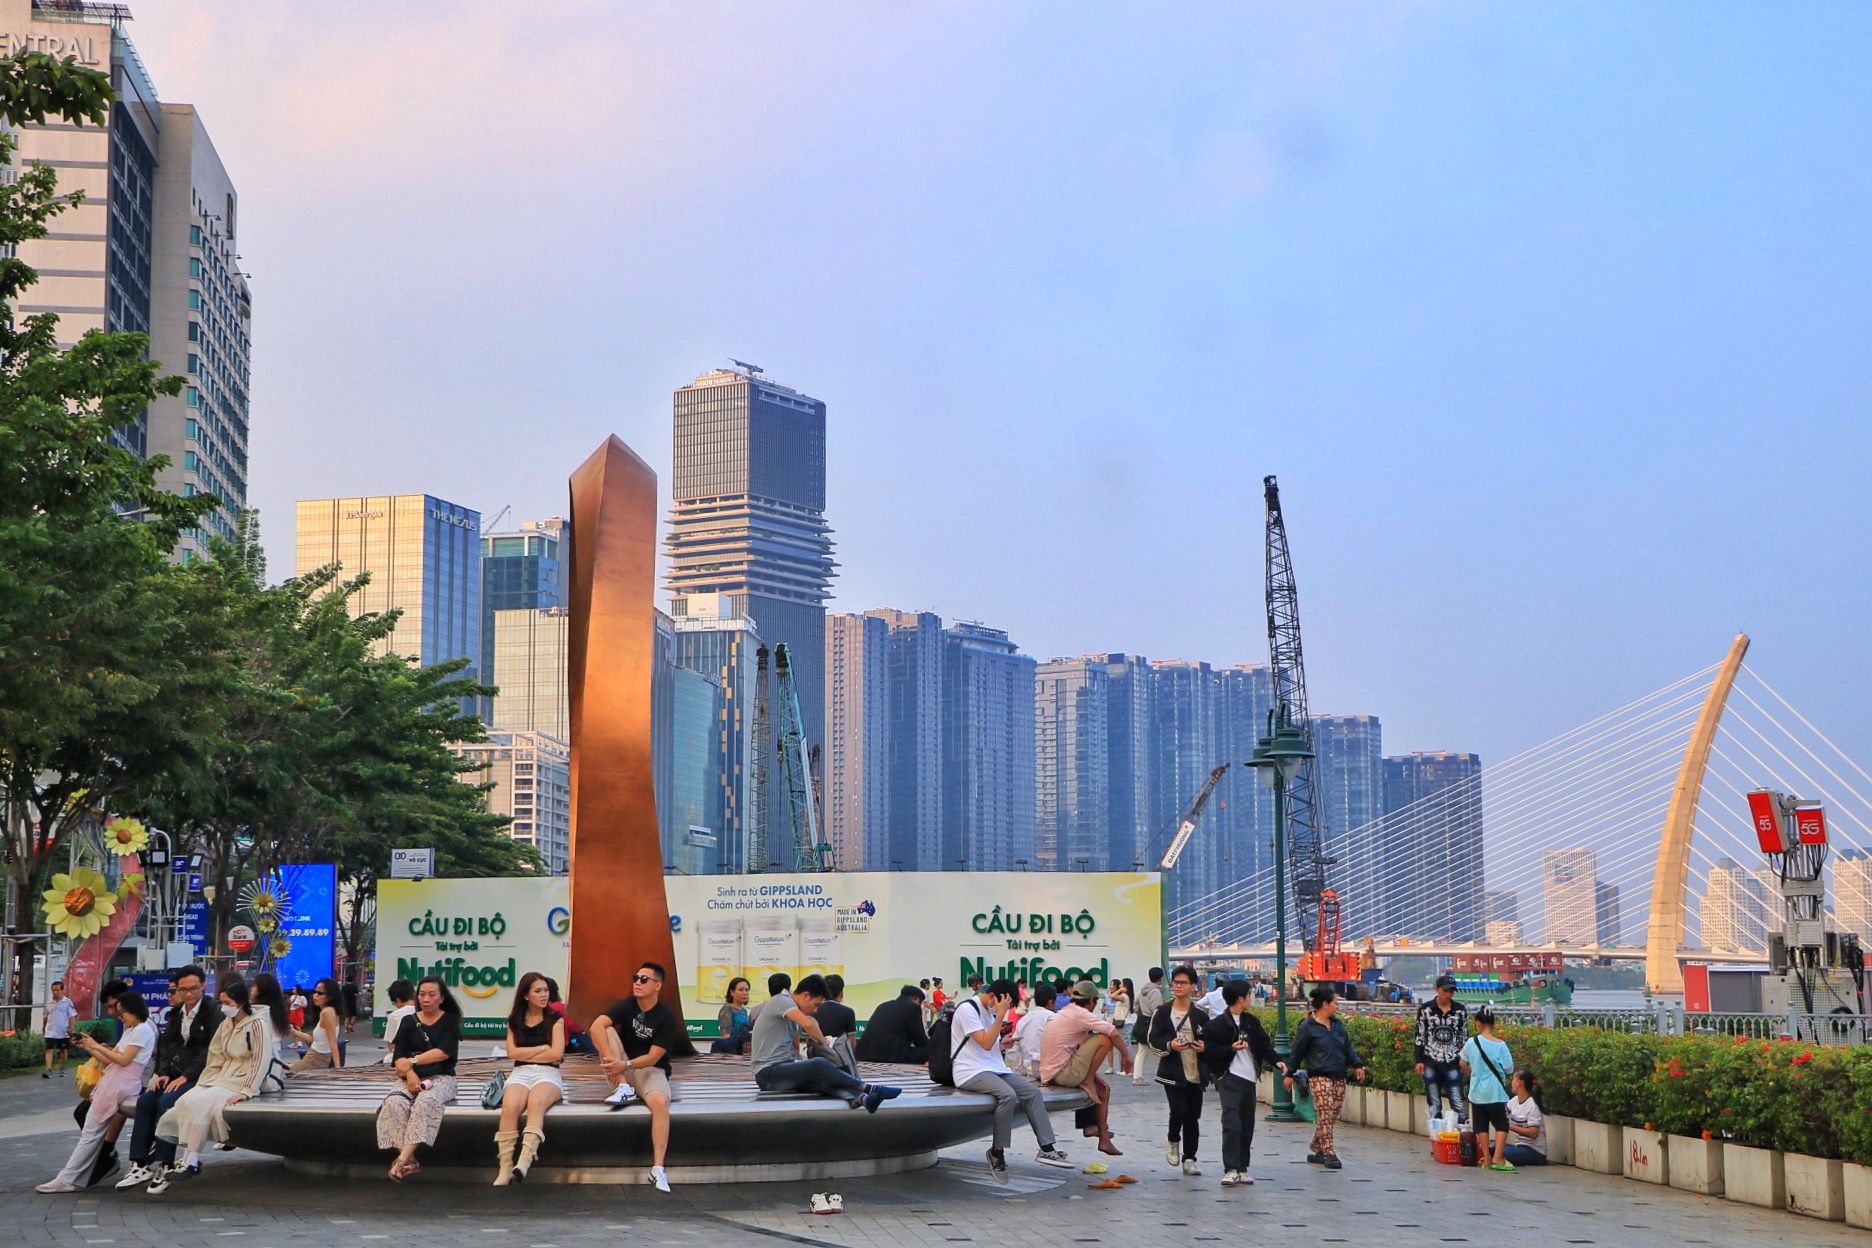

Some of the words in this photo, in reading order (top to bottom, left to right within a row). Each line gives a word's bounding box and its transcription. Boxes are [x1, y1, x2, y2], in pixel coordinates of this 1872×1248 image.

[692, 379, 713, 388] SAIGON
[431, 508, 449, 521] THE
[449, 513, 477, 531] NEXUS
[1759, 818, 1772, 831] 5G
[1800, 822, 1820, 835] 5G
[717, 886, 736, 897] Sinh
[738, 888, 747, 896] ra
[749, 886, 758, 896] từ
[759, 885, 823, 896] GIPPSLAND
[707, 899, 733, 909] Chăm
[735, 899, 753, 909] chút
[755, 898, 770, 909] bởi
[772, 898, 805, 908] KHOA
[807, 897, 833, 911] HỌC
[409, 909, 449, 936] CẦU
[453, 917, 473, 936] ĐI
[478, 911, 506, 940] BỘ
[971, 904, 1022, 933] CẦU
[1029, 913, 1052, 933] ĐI
[1060, 908, 1095, 939] BỘ
[435, 941, 448, 951] Tài
[449, 942, 463, 953] trợ
[463, 940, 478, 951] bởi
[1006, 939, 1022, 950] Tài
[1024, 940, 1041, 952] trợ
[1042, 939, 1060, 950] bởi
[960, 956, 1108, 989] Nutifood
